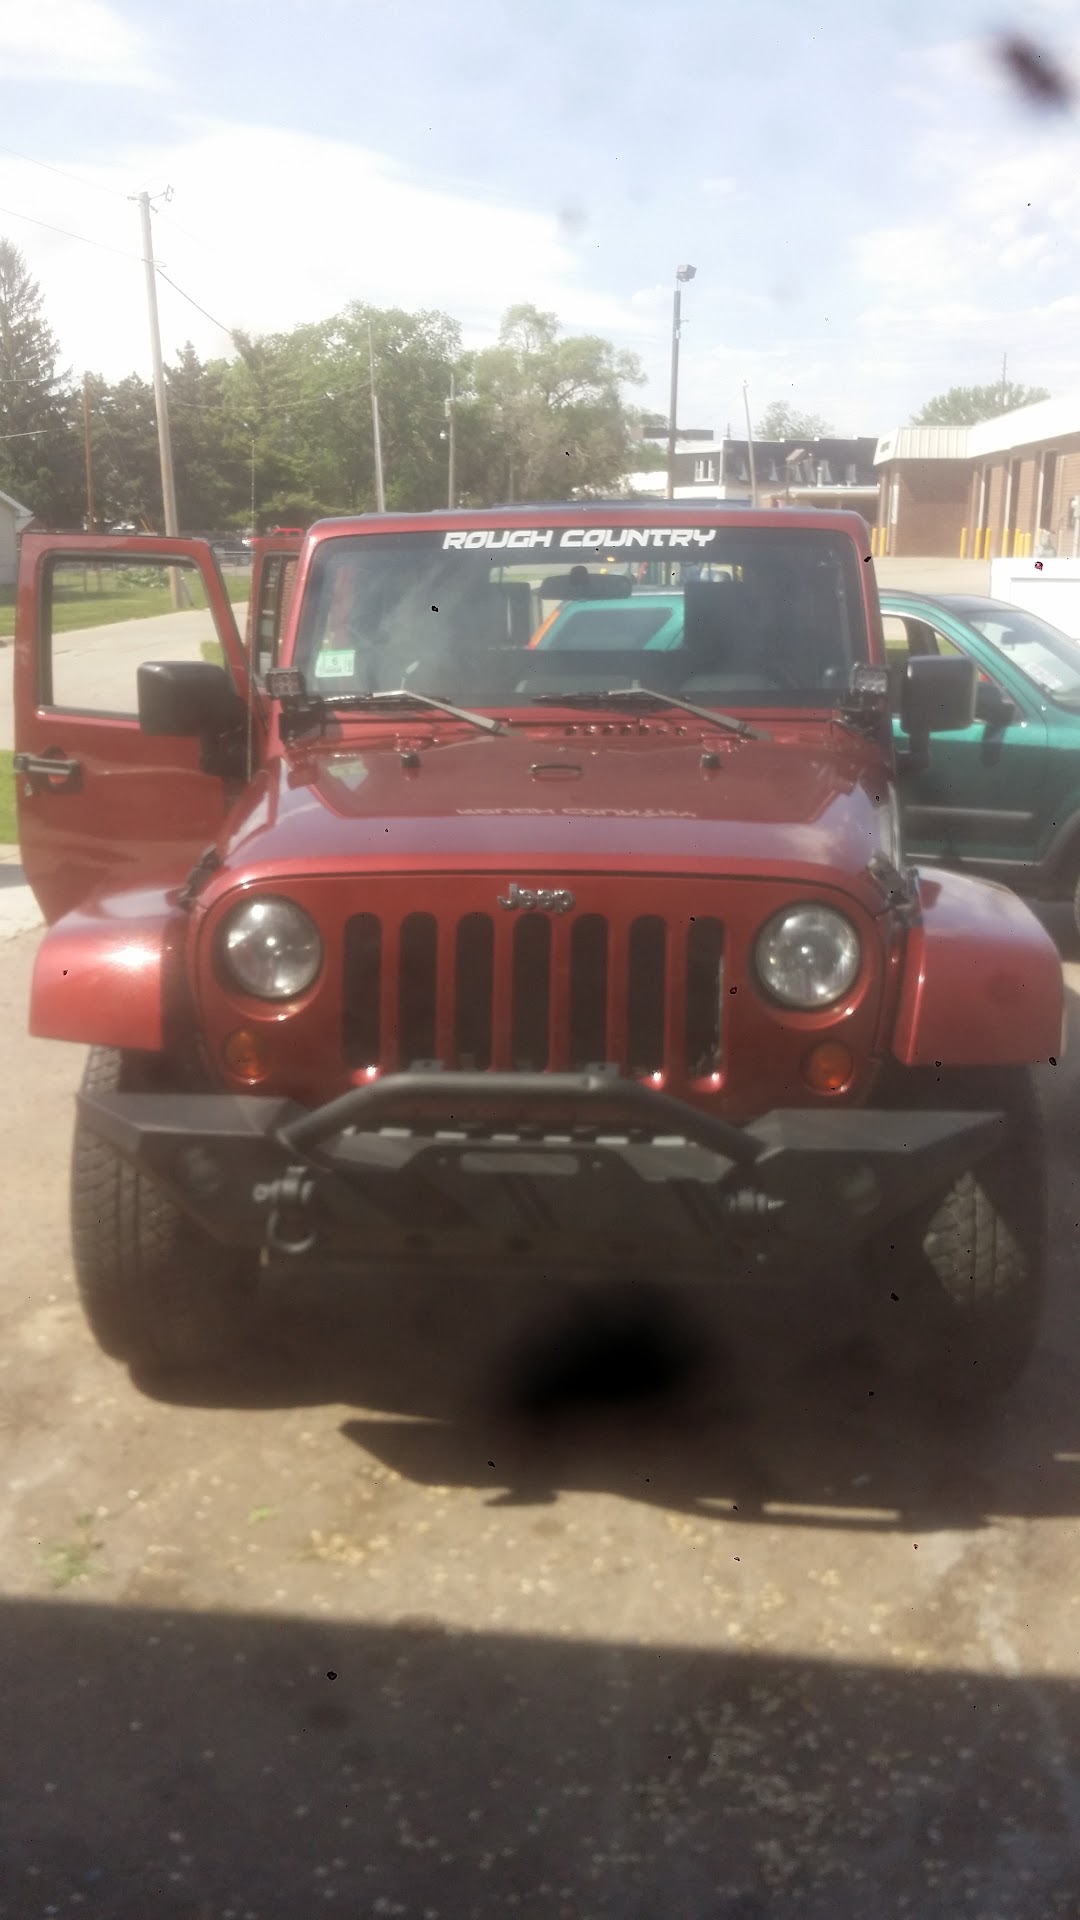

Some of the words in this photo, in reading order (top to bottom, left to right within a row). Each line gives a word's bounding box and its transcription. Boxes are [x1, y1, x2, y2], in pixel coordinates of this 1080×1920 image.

[442, 530, 554, 550] ROUGH
[559, 528, 717, 547] COUNTRY
[497, 883, 576, 914] Jeep
